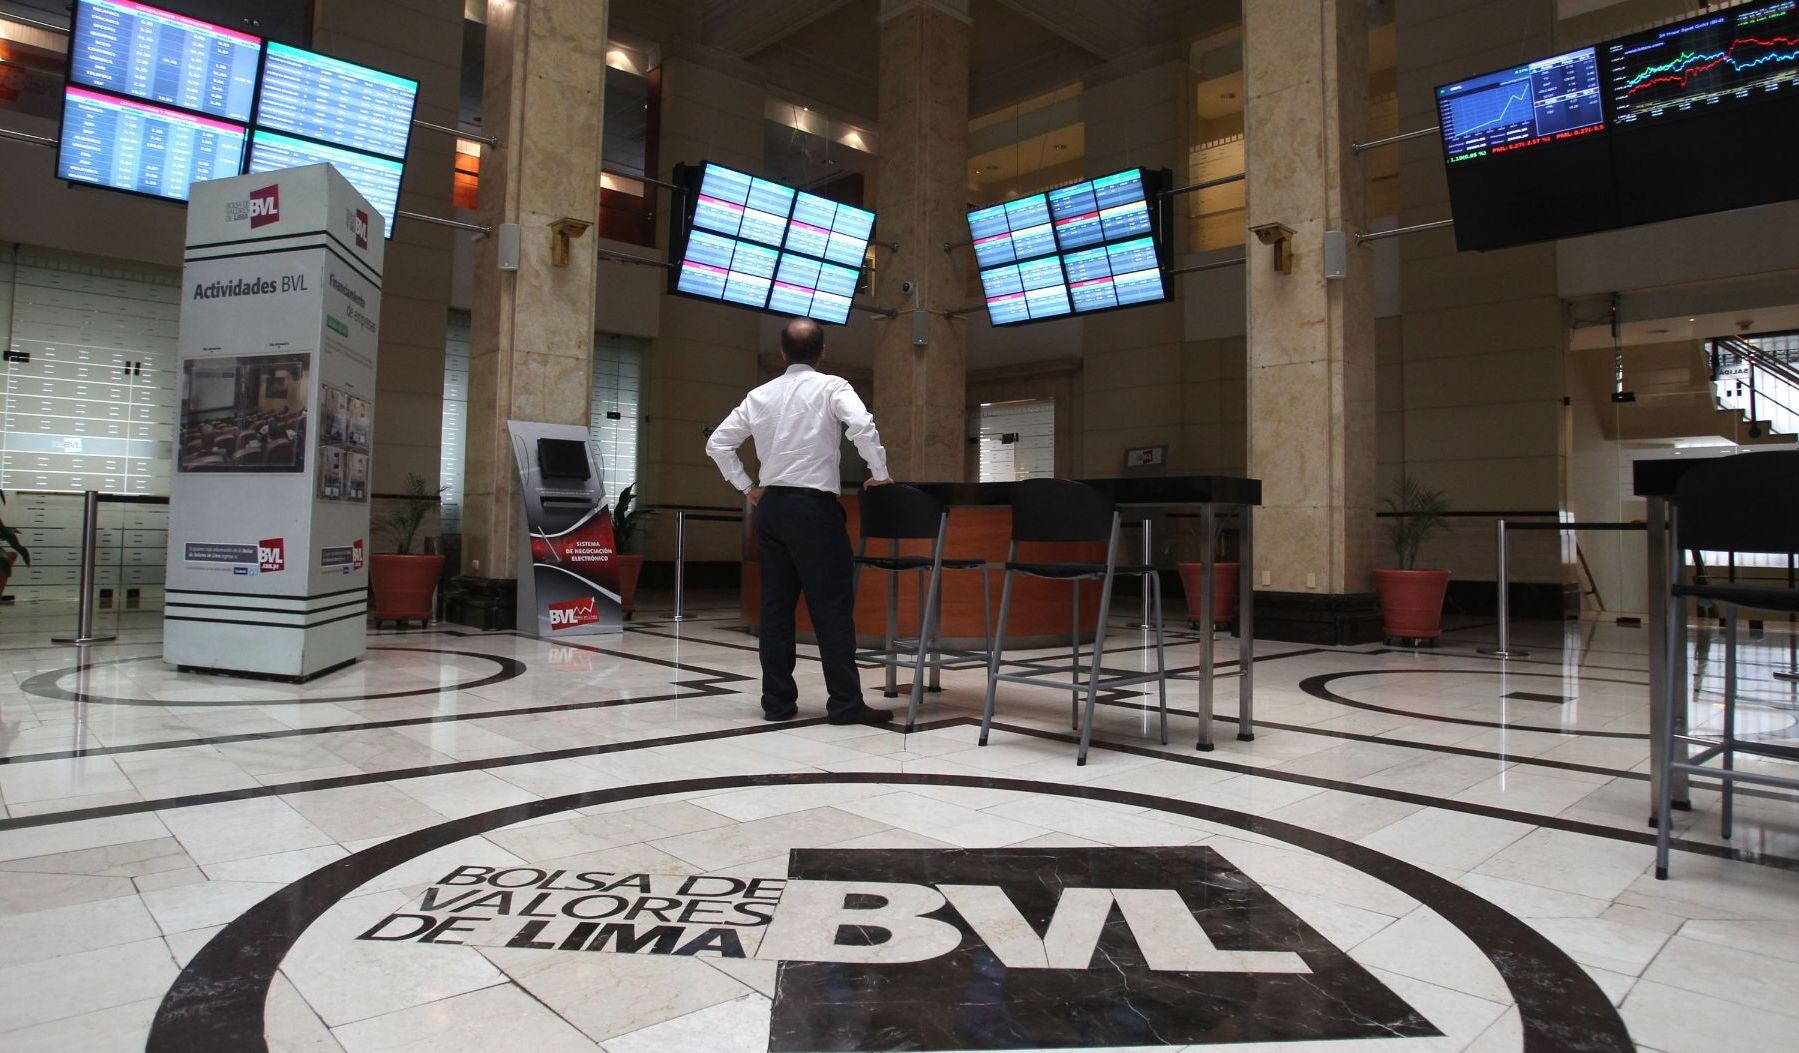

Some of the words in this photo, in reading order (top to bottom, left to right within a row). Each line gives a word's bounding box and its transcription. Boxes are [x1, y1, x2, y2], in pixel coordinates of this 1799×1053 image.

[250, 197, 278, 217] BVL
[355, 216, 368, 242] BVL
[193, 277, 278, 300] Actividades
[282, 275, 308, 293] BVL
[260, 547, 283, 564] BVL
[549, 609, 578, 624] BVL
[436, 865, 652, 894] BOLSA
[676, 875, 788, 900] DE
[418, 887, 781, 927] VALORES
[353, 912, 493, 945] DE
[504, 919, 748, 959] LIMA
[756, 880, 1314, 974] BVL
